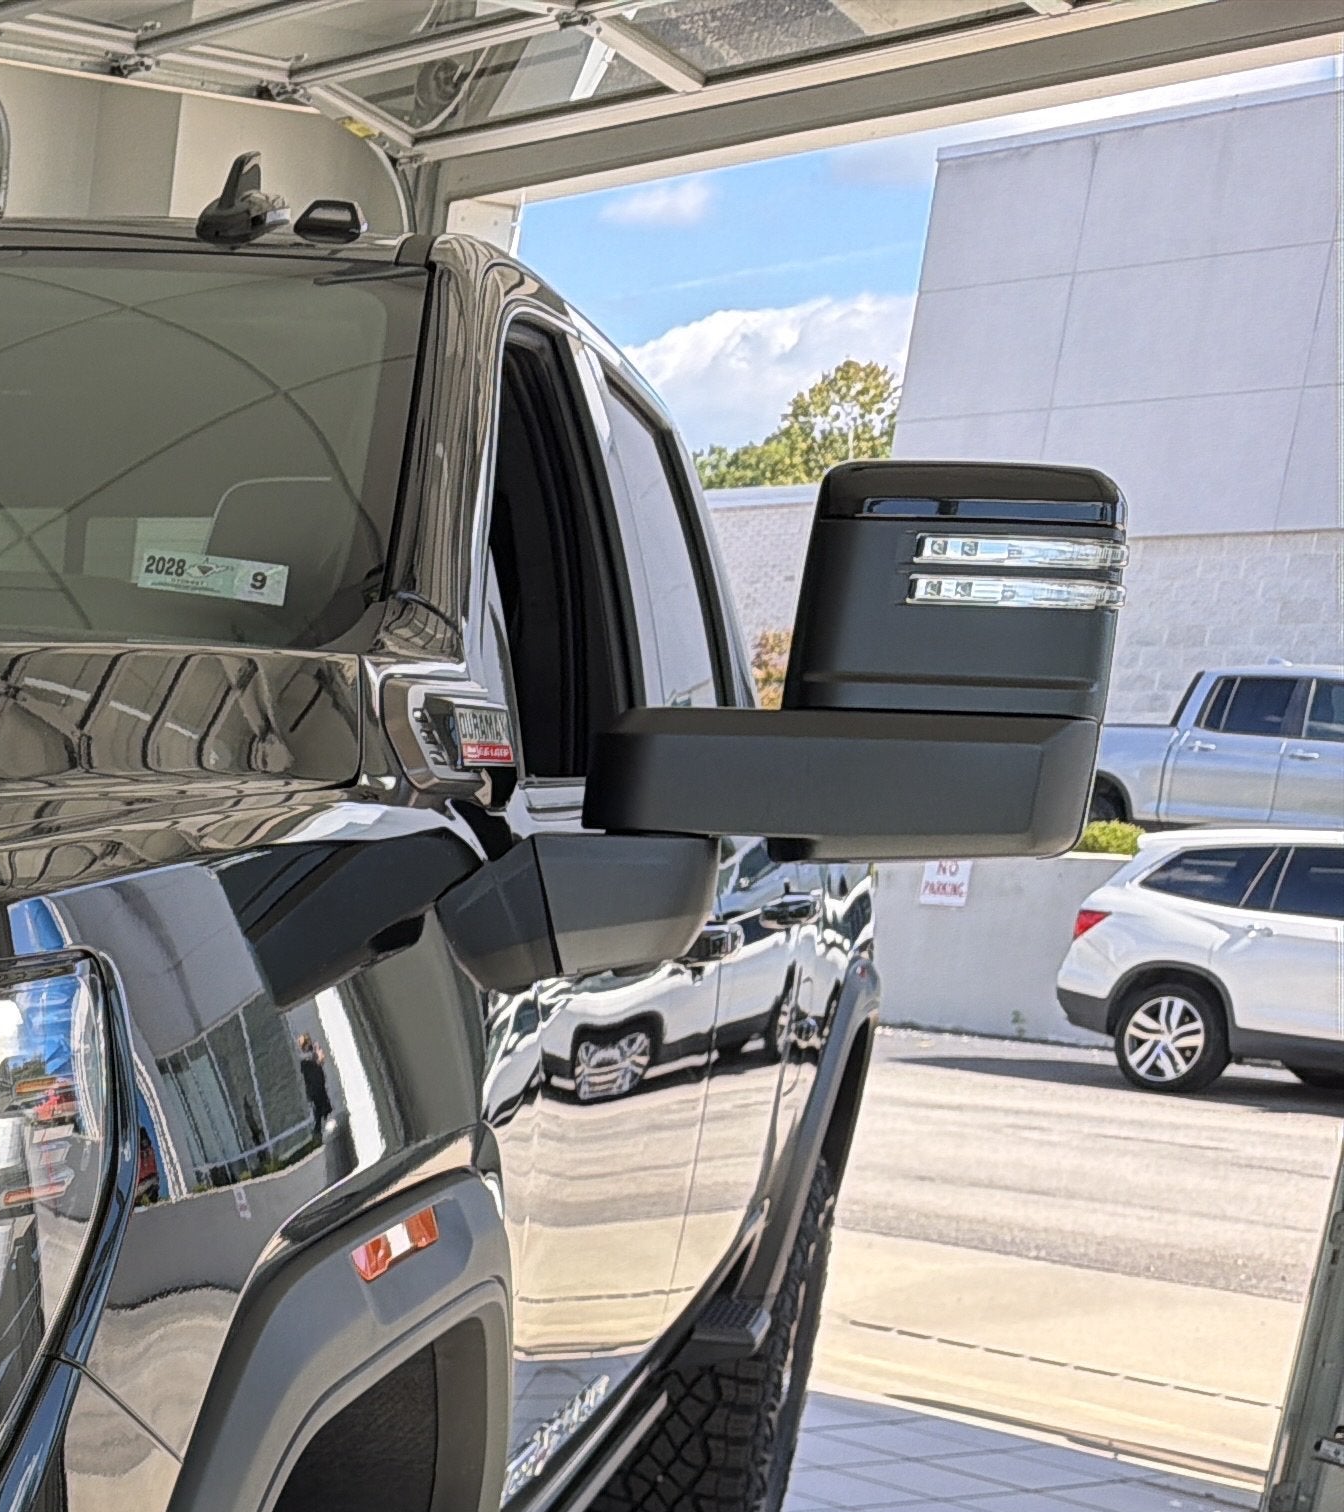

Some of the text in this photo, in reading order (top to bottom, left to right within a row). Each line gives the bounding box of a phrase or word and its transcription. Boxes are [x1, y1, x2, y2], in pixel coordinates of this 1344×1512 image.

[144, 555, 187, 577] 2028
[250, 571, 267, 590] 9
[936, 859, 960, 876] NO
